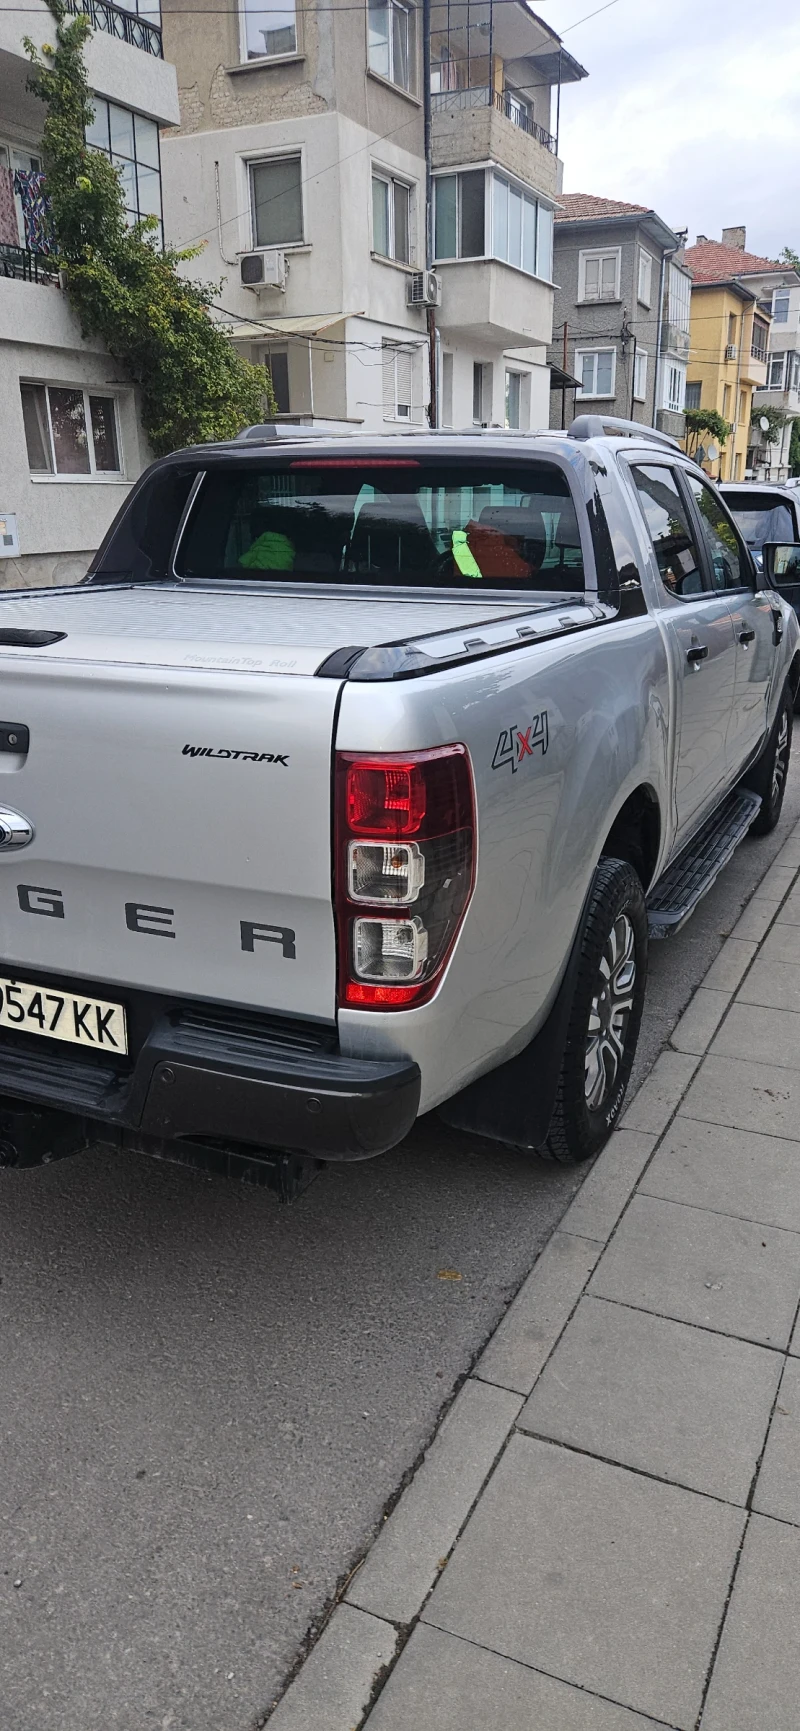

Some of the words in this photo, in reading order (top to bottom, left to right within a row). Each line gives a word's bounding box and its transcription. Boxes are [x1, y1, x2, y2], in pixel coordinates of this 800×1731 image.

[269, 659, 297, 668] Roll
[181, 744, 290, 767] WILDTRAK
[0, 984, 65, 1032] 547
[72, 1000, 119, 1048] KK
